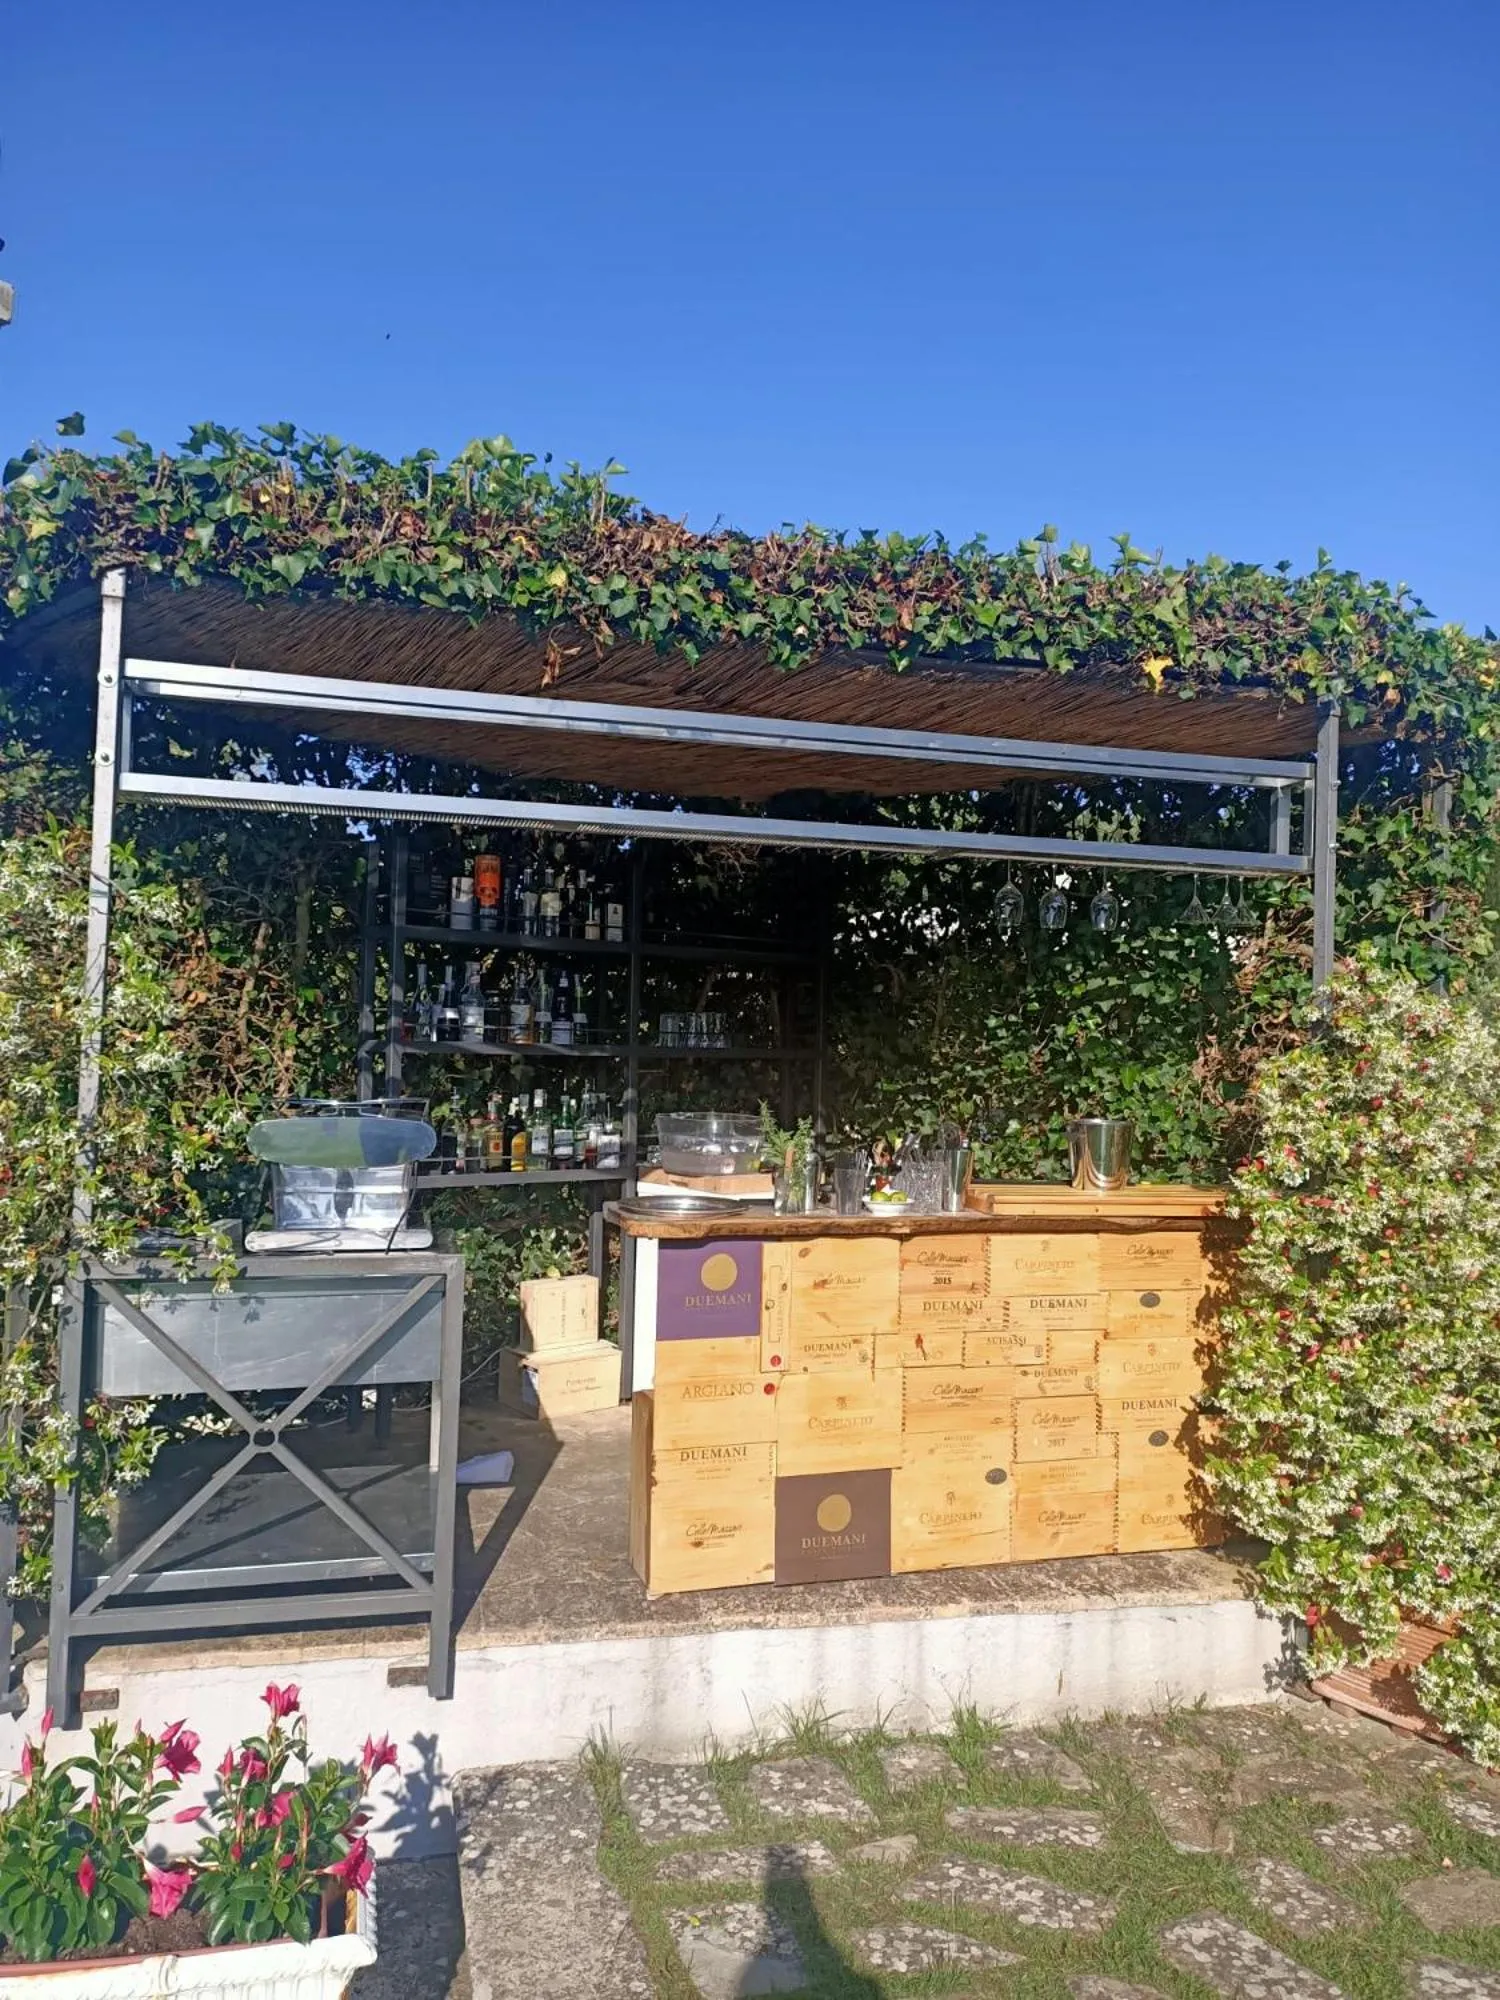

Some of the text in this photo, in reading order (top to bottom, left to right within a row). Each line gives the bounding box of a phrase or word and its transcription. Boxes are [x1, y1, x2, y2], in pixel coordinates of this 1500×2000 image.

[685, 1293, 751, 1308] DUEMANI
[923, 1300, 983, 1312] DUEMANI
[1029, 1298, 1088, 1309] DUEMANI
[682, 1382, 754, 1399] ARGIANO
[1121, 1398, 1178, 1411] DUEMANI
[680, 1446, 748, 1462] DUEMANI
[801, 1534, 867, 1549] DUEMANI
